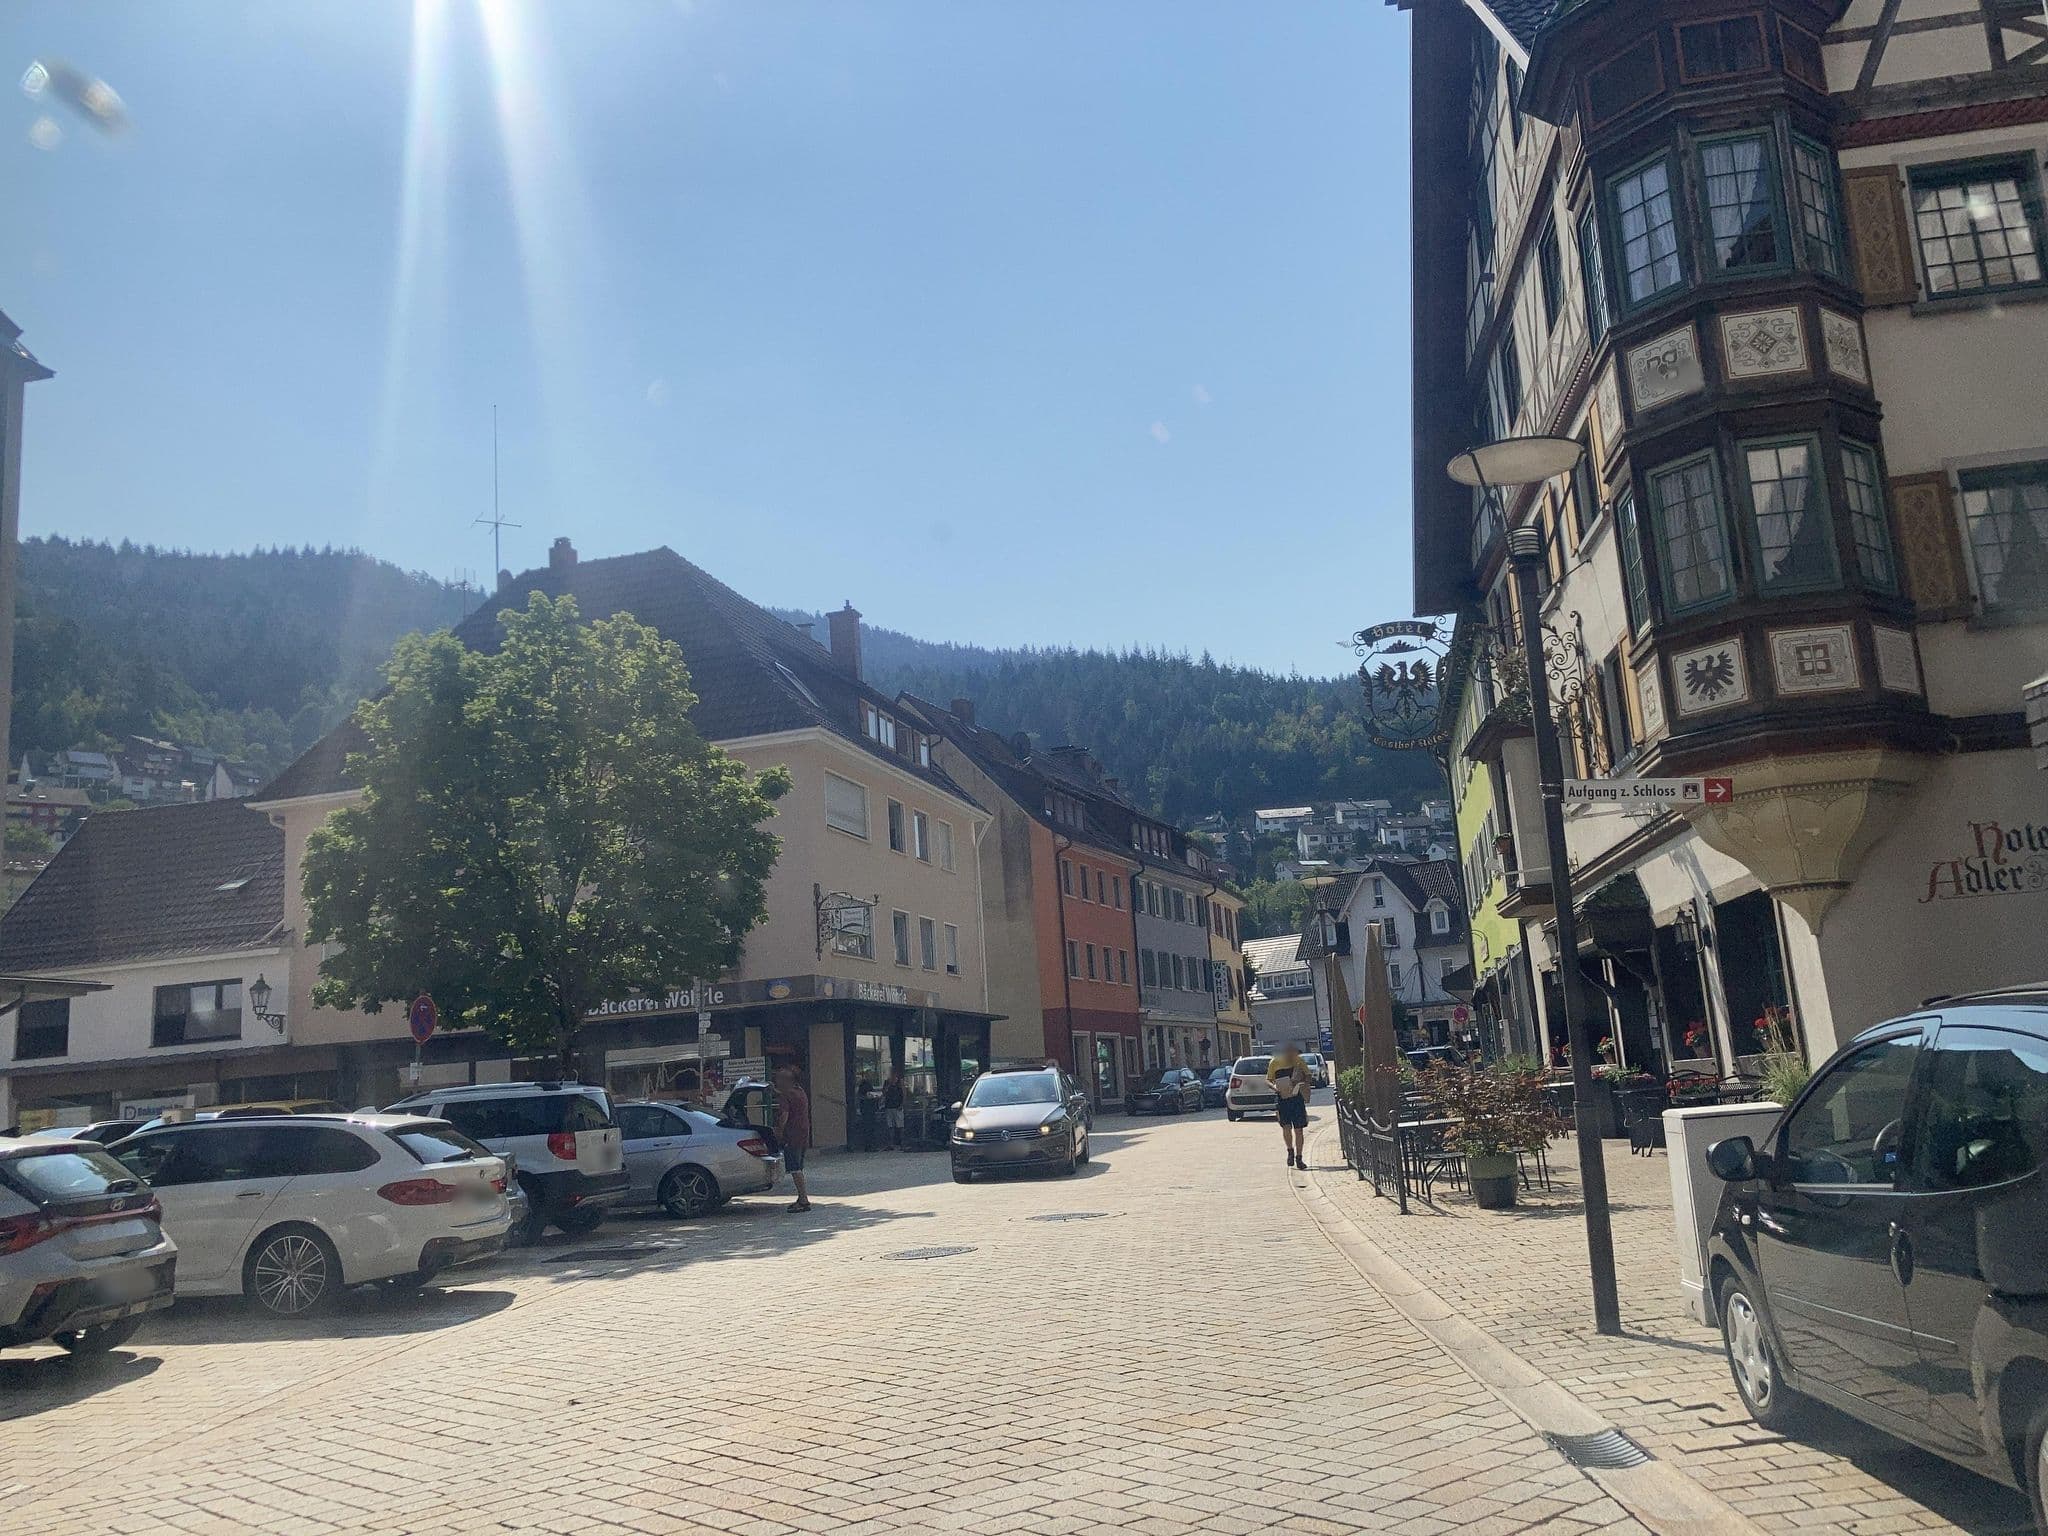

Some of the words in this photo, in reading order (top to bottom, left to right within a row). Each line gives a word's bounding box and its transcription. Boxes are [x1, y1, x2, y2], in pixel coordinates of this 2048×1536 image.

[1371, 622, 1423, 638] Hotel
[1568, 786, 1617, 800] Aufgang
[1620, 789, 1630, 797] z.
[1633, 785, 1676, 797] Schloss
[1918, 857, 2023, 903] Adler
